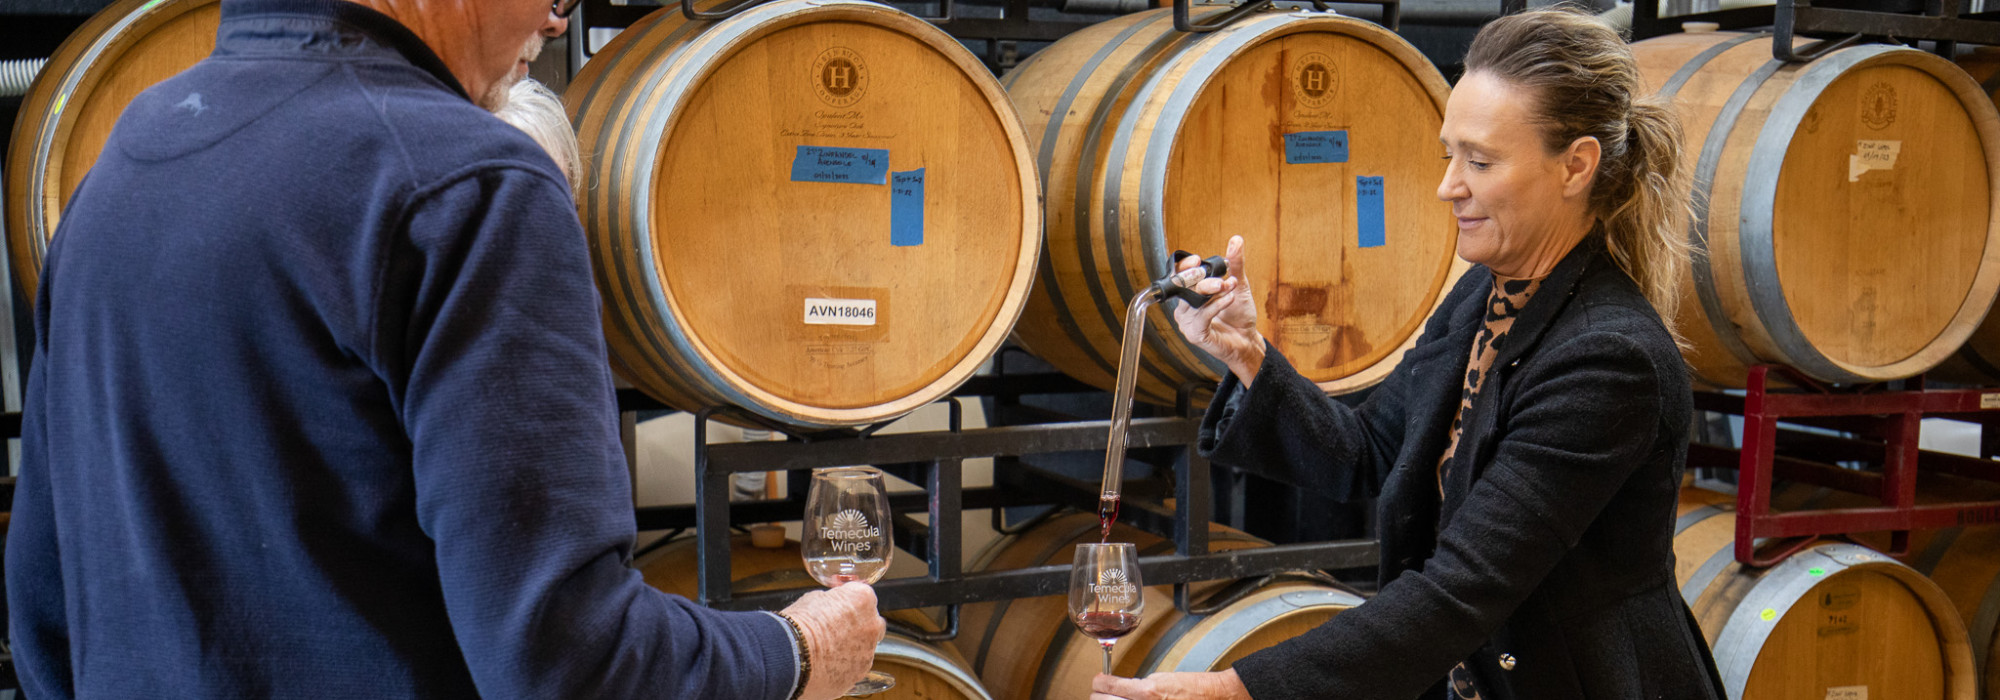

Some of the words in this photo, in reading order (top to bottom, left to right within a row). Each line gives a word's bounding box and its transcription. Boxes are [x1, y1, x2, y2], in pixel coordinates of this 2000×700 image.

[829, 66, 851, 89] H
[1305, 69, 1325, 91] H
[809, 305, 874, 318] AVN18046
[821, 525, 880, 540] Temecula
[831, 540, 871, 552] Wines
[1088, 582, 1137, 593] Temecula
[1098, 593, 1131, 604] Wines
